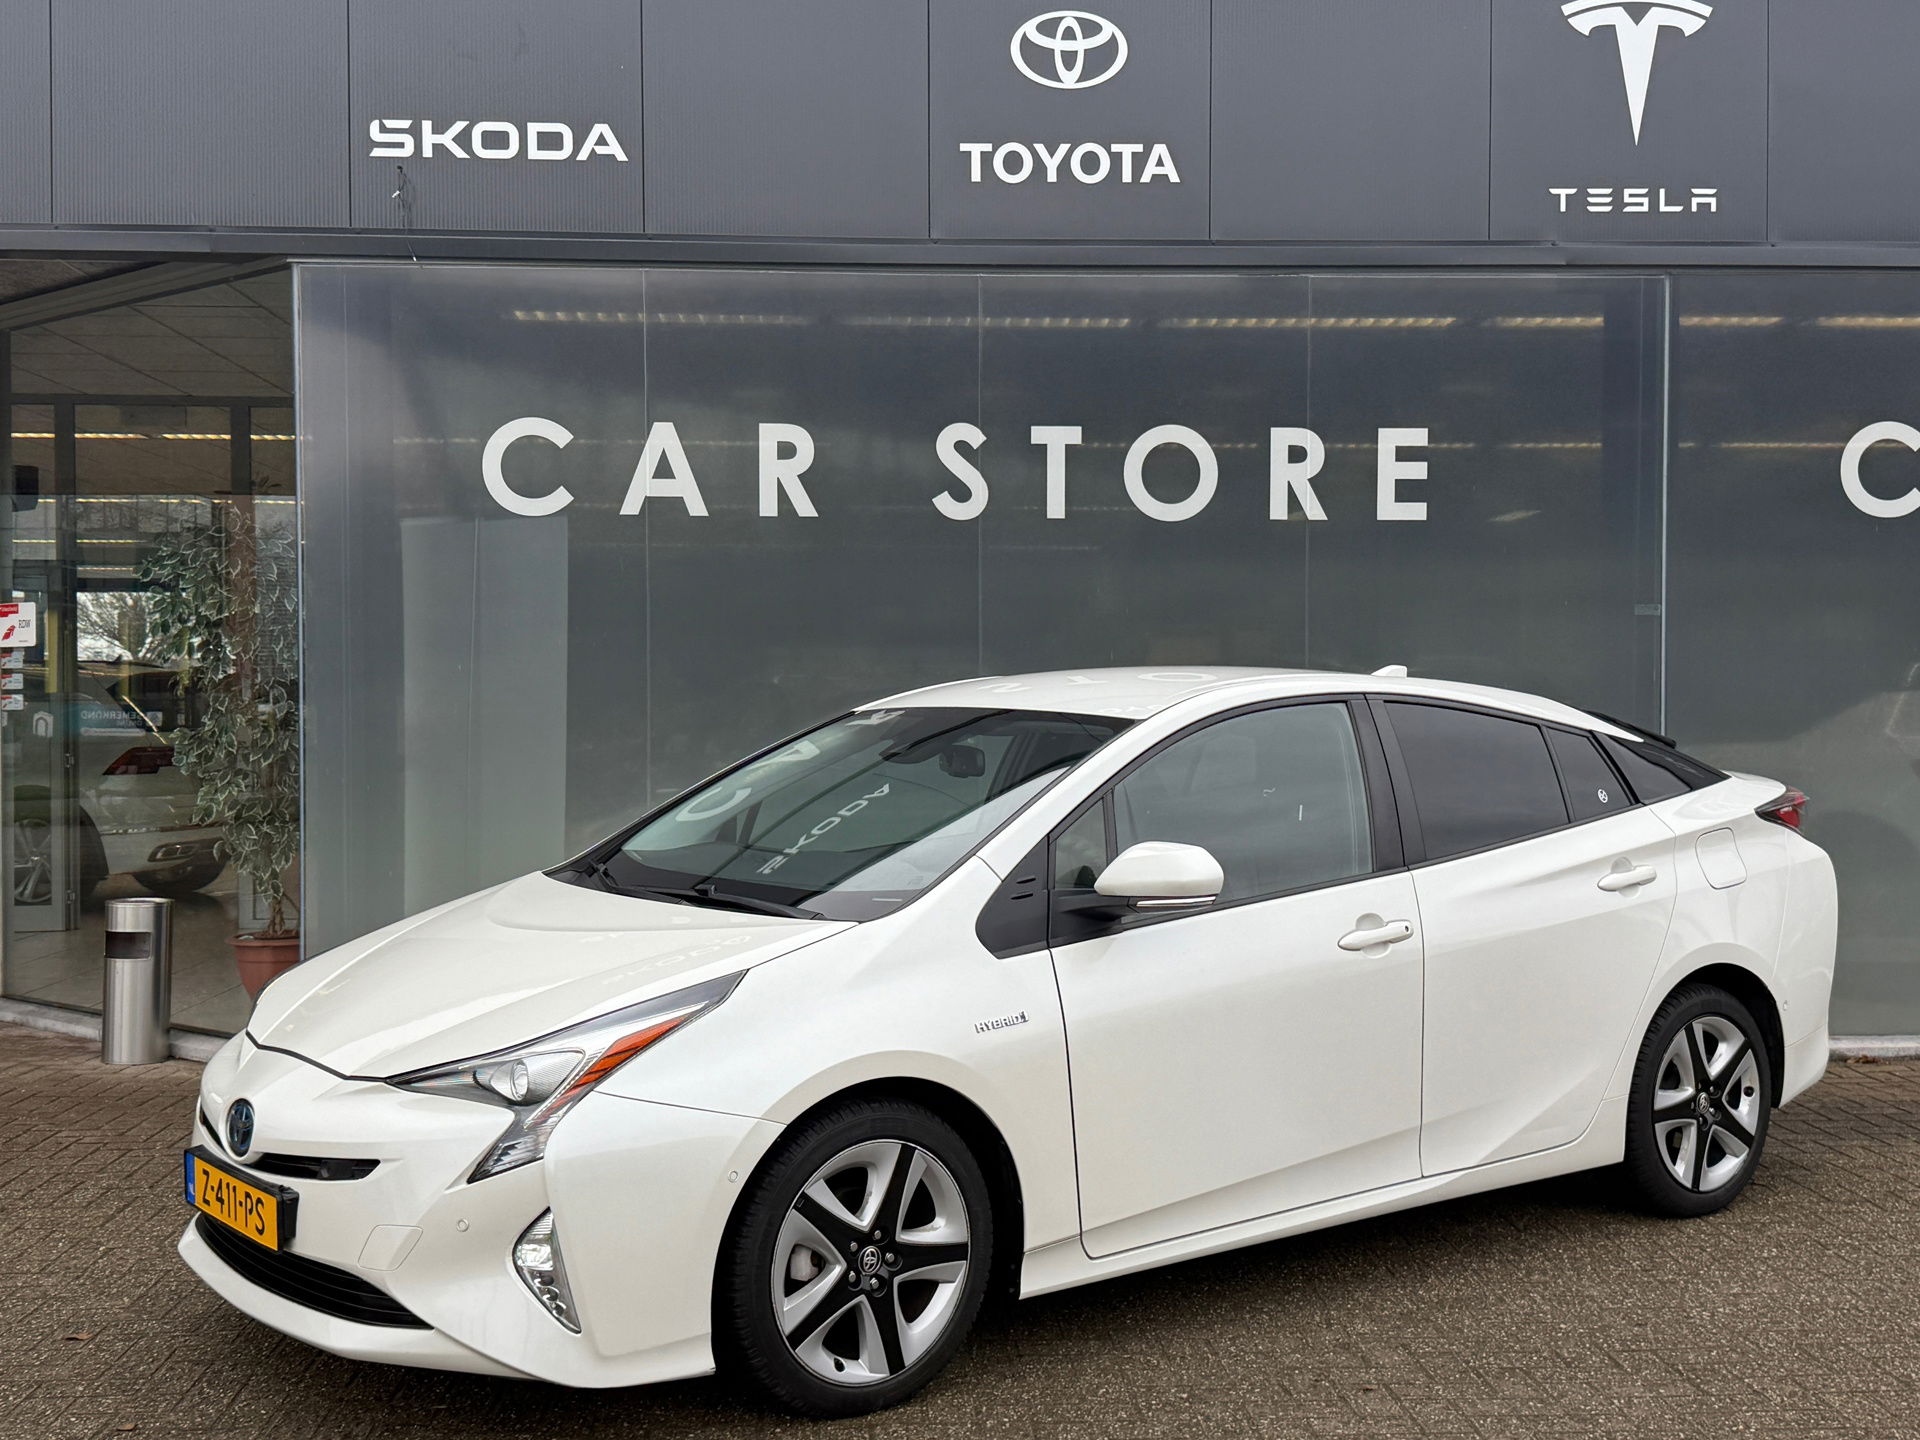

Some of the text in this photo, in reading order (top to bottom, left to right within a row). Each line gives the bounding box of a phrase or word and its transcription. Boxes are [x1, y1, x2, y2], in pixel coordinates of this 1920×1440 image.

[369, 119, 629, 162] SKODA
[959, 141, 1181, 184] TOYOTA
[1548, 187, 1718, 212] TESLA
[482, 416, 1430, 522] CAR STORE
[974, 1013, 1022, 1034] HYBRID
[201, 1167, 266, 1236] Z-411-PS
